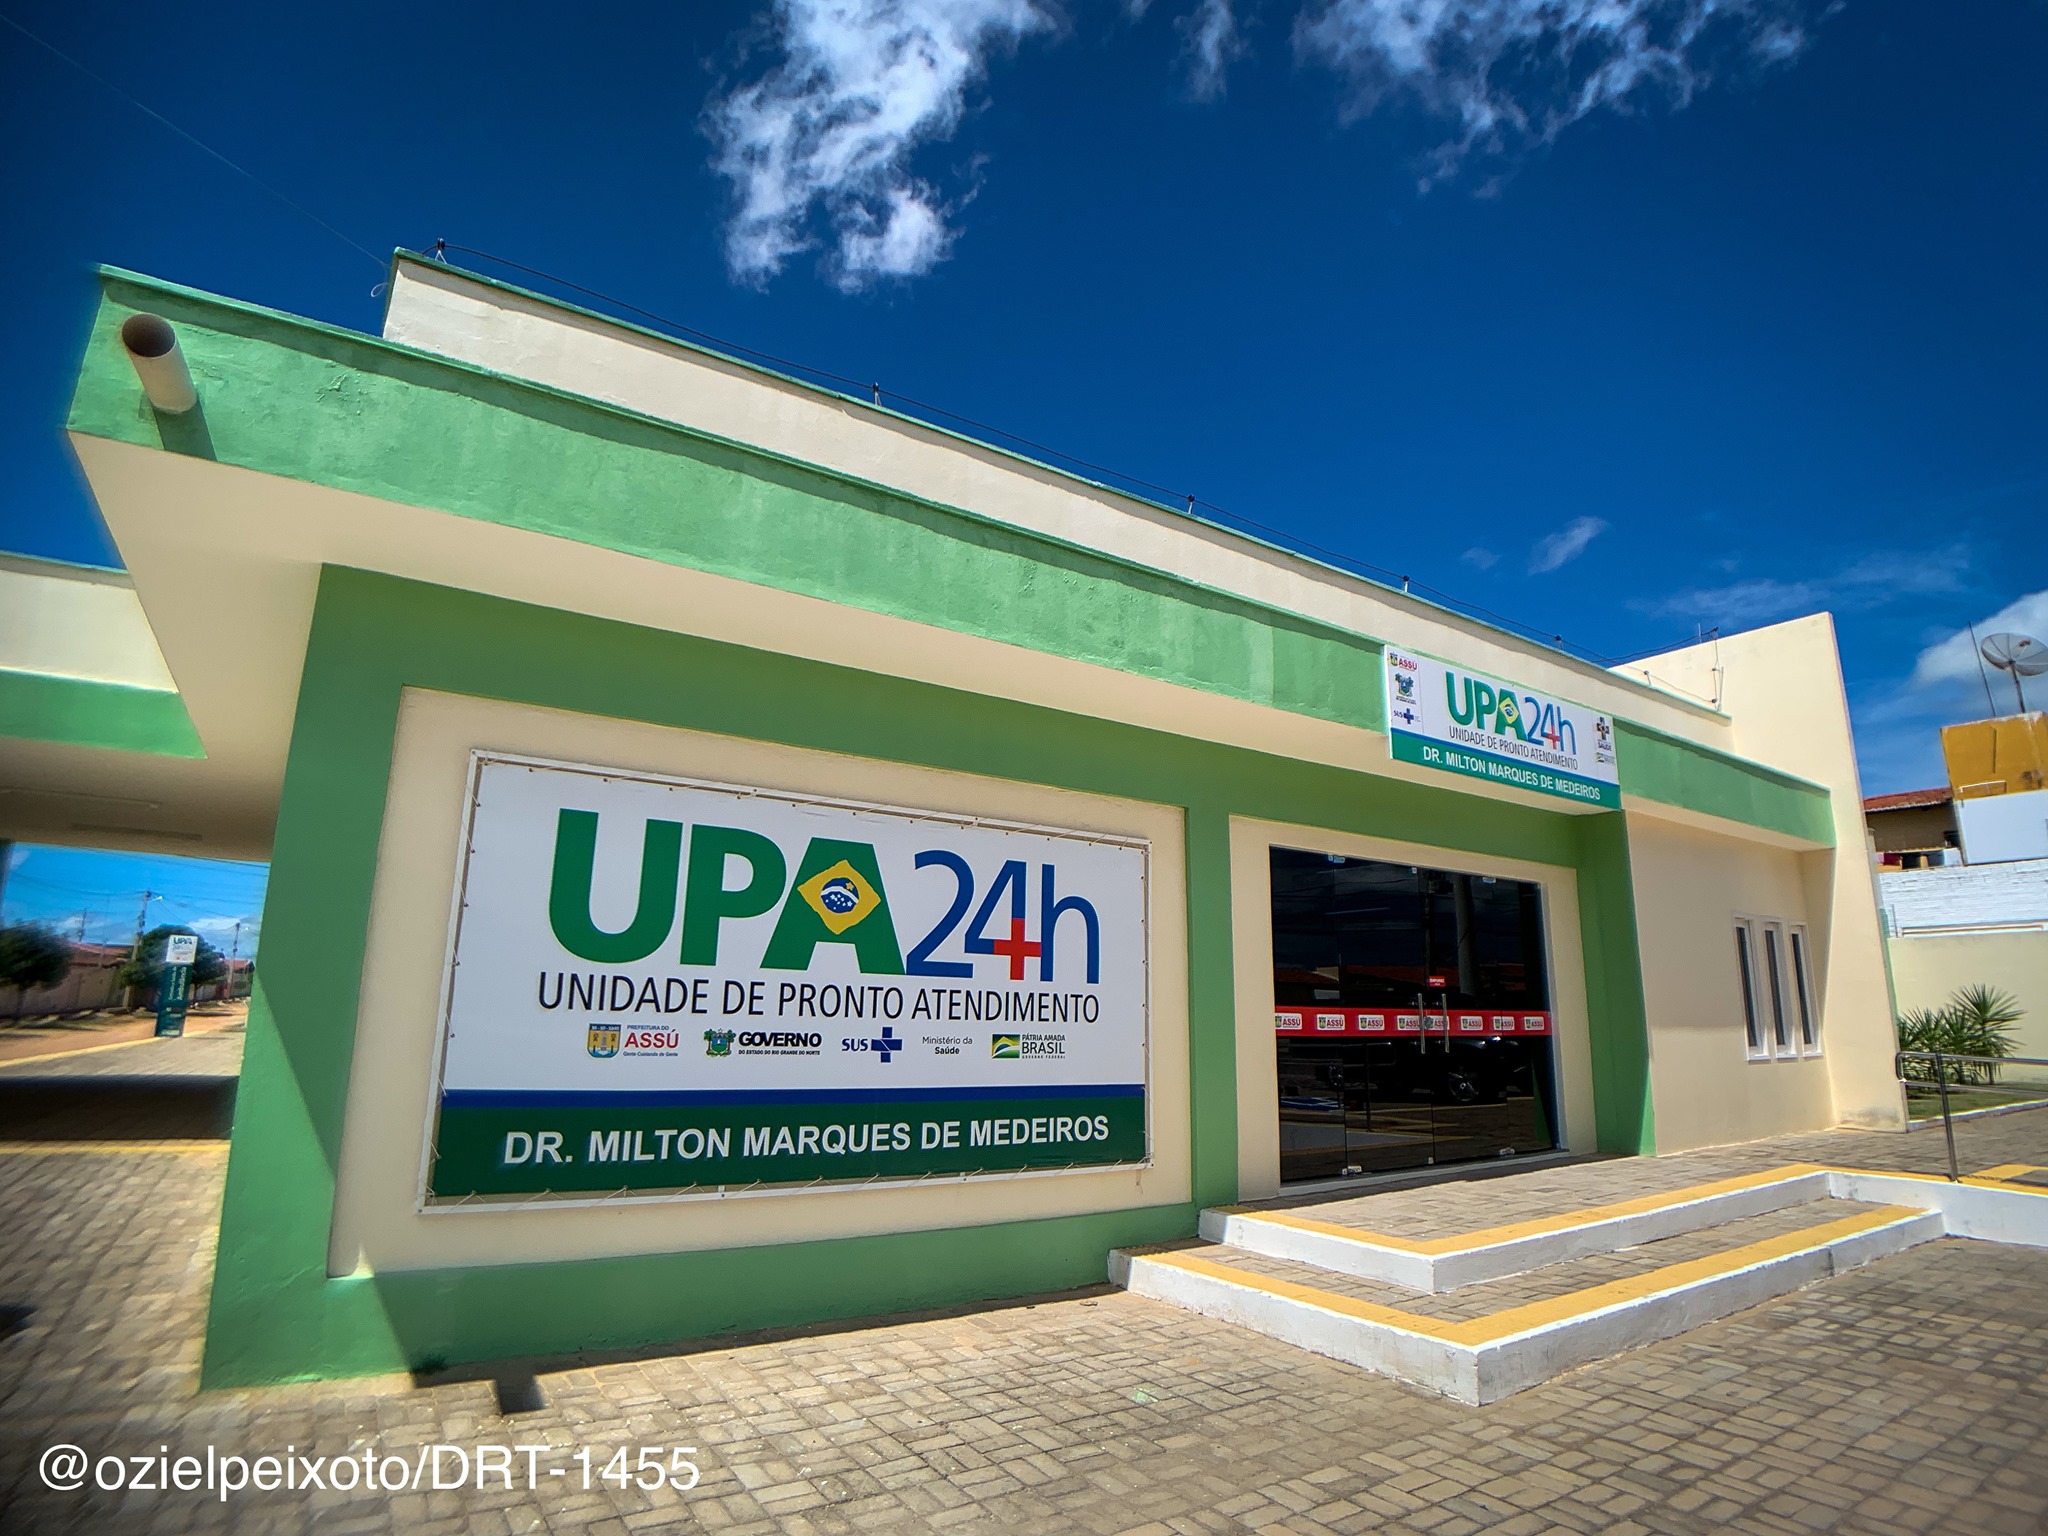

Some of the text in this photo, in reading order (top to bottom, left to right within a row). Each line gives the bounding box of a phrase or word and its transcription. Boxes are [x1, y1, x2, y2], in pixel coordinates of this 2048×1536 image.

[1445, 671, 1528, 742] UPA
[1449, 725, 1579, 770] UNIDADE DE PRONTO ATENDIMENTO
[1423, 745, 1601, 801] DR. MILTON MARQUES DE MEDEIROS
[549, 807, 1100, 985] UPA 24h
[538, 971, 1100, 1024] UNIDADE DE PRONTO ATENDIMENTO
[624, 1029, 680, 1049] ASSÚ
[738, 1031, 822, 1048] GOVERNO
[841, 1038, 868, 1051] SUS
[922, 1036, 973, 1045] Ministério da
[1022, 1033, 1043, 1041] PÁTRIA
[934, 1045, 960, 1055] Saúde
[1022, 1042, 1066, 1054] BRASIL
[503, 1115, 1109, 1164] DR. MILTON MARQUES DE MEDEIROS
